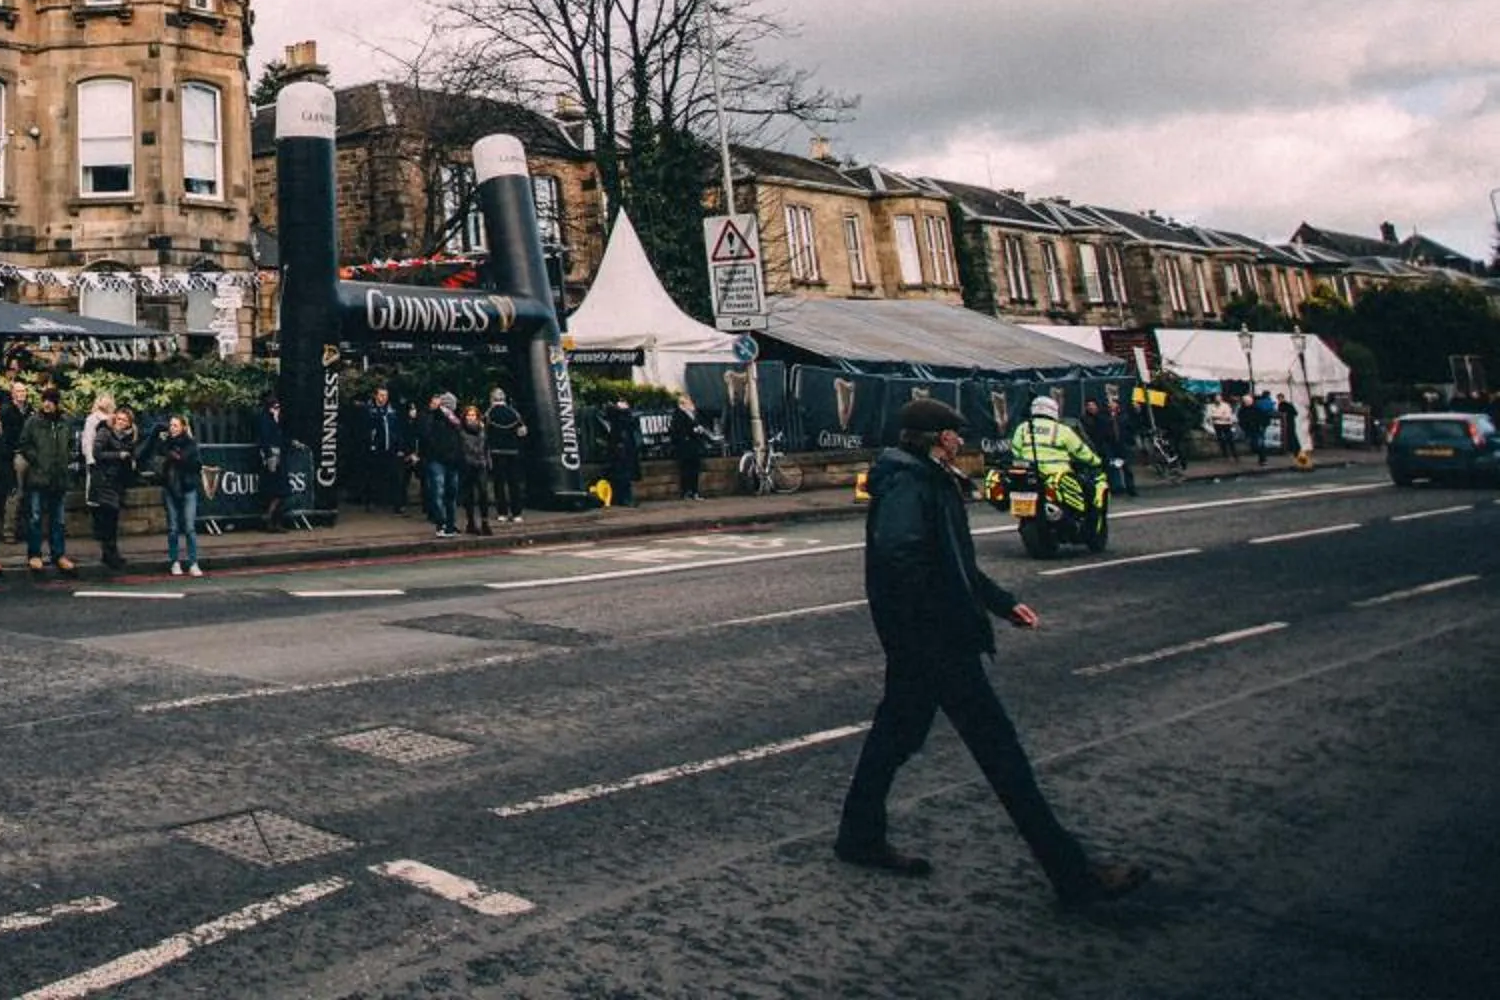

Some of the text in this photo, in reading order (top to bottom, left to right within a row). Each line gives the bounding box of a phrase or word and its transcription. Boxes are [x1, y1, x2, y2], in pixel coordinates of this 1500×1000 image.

[366, 288, 489, 332] GUINNESS
[731, 318, 751, 327] End
[316, 371, 340, 487] GUINNESS
[555, 370, 581, 470] GUINNESS
[221, 470, 307, 495] GUISS
